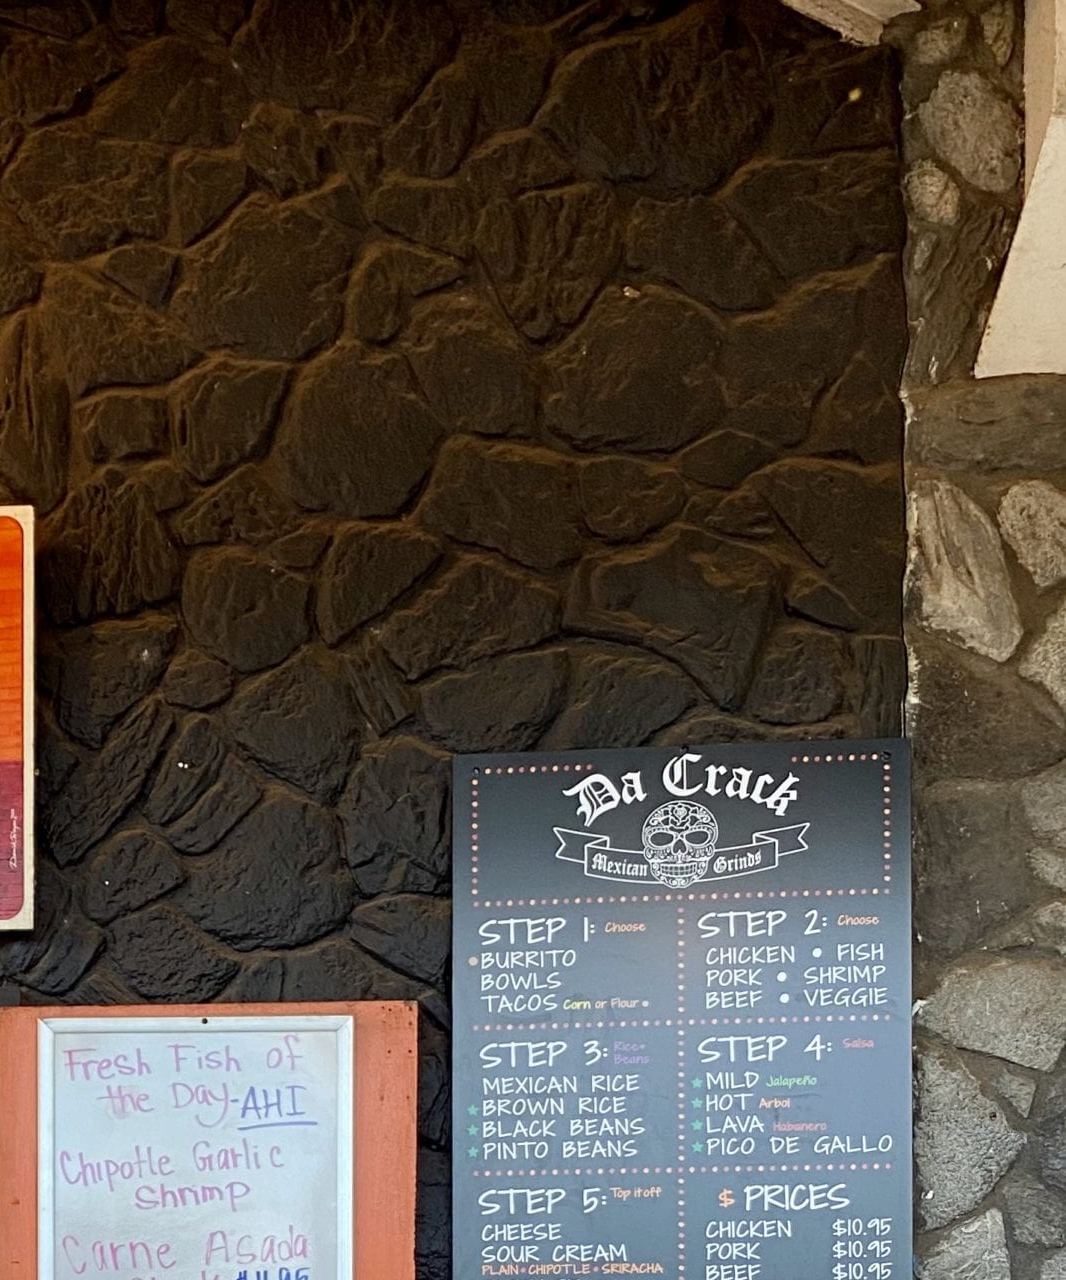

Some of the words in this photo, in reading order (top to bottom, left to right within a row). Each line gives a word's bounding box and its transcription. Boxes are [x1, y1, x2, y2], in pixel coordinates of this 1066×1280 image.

[563, 770, 647, 826] Da
[663, 753, 799, 816] Crack
[591, 852, 648, 876] Mexican
[713, 850, 762, 873] Grinds
[479, 918, 566, 944] STEP
[605, 921, 646, 933] Choose
[698, 910, 786, 938] STEP
[838, 914, 879, 925] Choose
[481, 950, 576, 968] BURRITO
[705, 946, 794, 966] CHICKEN
[838, 943, 883, 960] FISH
[481, 973, 562, 991] BOWLS
[706, 968, 761, 987] PORK
[804, 964, 886, 984] SHRIMP
[485, 994, 558, 1012] TACOS
[563, 998, 590, 1009] Corn
[611, 997, 639, 1008] Flour
[705, 991, 761, 1009] BEEF
[804, 987, 887, 1007] VEGGIE
[64, 1048, 150, 1081] Fresh
[169, 1044, 241, 1073] Fish
[266, 1034, 303, 1071] of
[480, 1041, 567, 1068] STEP
[697, 1035, 787, 1063] STEP
[483, 1076, 577, 1095] MEXICAN
[592, 1074, 640, 1092] RICE
[706, 1071, 759, 1089] MILD
[98, 1085, 154, 1113] the
[483, 1098, 564, 1116] BROWN
[579, 1097, 626, 1114] RICE
[706, 1094, 753, 1111] HOT
[759, 1098, 790, 1108] Arbol
[483, 1120, 556, 1138] BLACK
[570, 1118, 645, 1136] BEANS
[706, 1115, 764, 1133] LAVA
[774, 1122, 826, 1131] Habanero
[483, 1141, 548, 1159] PINTO
[563, 1140, 637, 1158] BEANS
[707, 1137, 754, 1155] PICO
[770, 1136, 799, 1154] DE
[814, 1135, 892, 1155] GALLO
[60, 1145, 175, 1189] Chipotle
[193, 1138, 284, 1171] Garlic
[478, 1188, 565, 1215] STEP
[744, 1184, 850, 1211] PRICES
[482, 1223, 562, 1241] CHEESE
[706, 1220, 792, 1238] CHICKEN
[833, 1218, 892, 1236] $10.95
[62, 1236, 176, 1274] Carne
[206, 1225, 307, 1265] Asada
[482, 1246, 539, 1263] SOUR
[552, 1244, 627, 1262] CREAM
[706, 1243, 761, 1260] PORK
[833, 1241, 892, 1258] $10.95
[482, 1265, 519, 1275] PLAIN
[528, 1264, 590, 1274] CHIPOTLE
[602, 1263, 663, 1274] SRIRACHA
[706, 1265, 761, 1280] BEEF
[833, 1263, 892, 1280] $10.95
